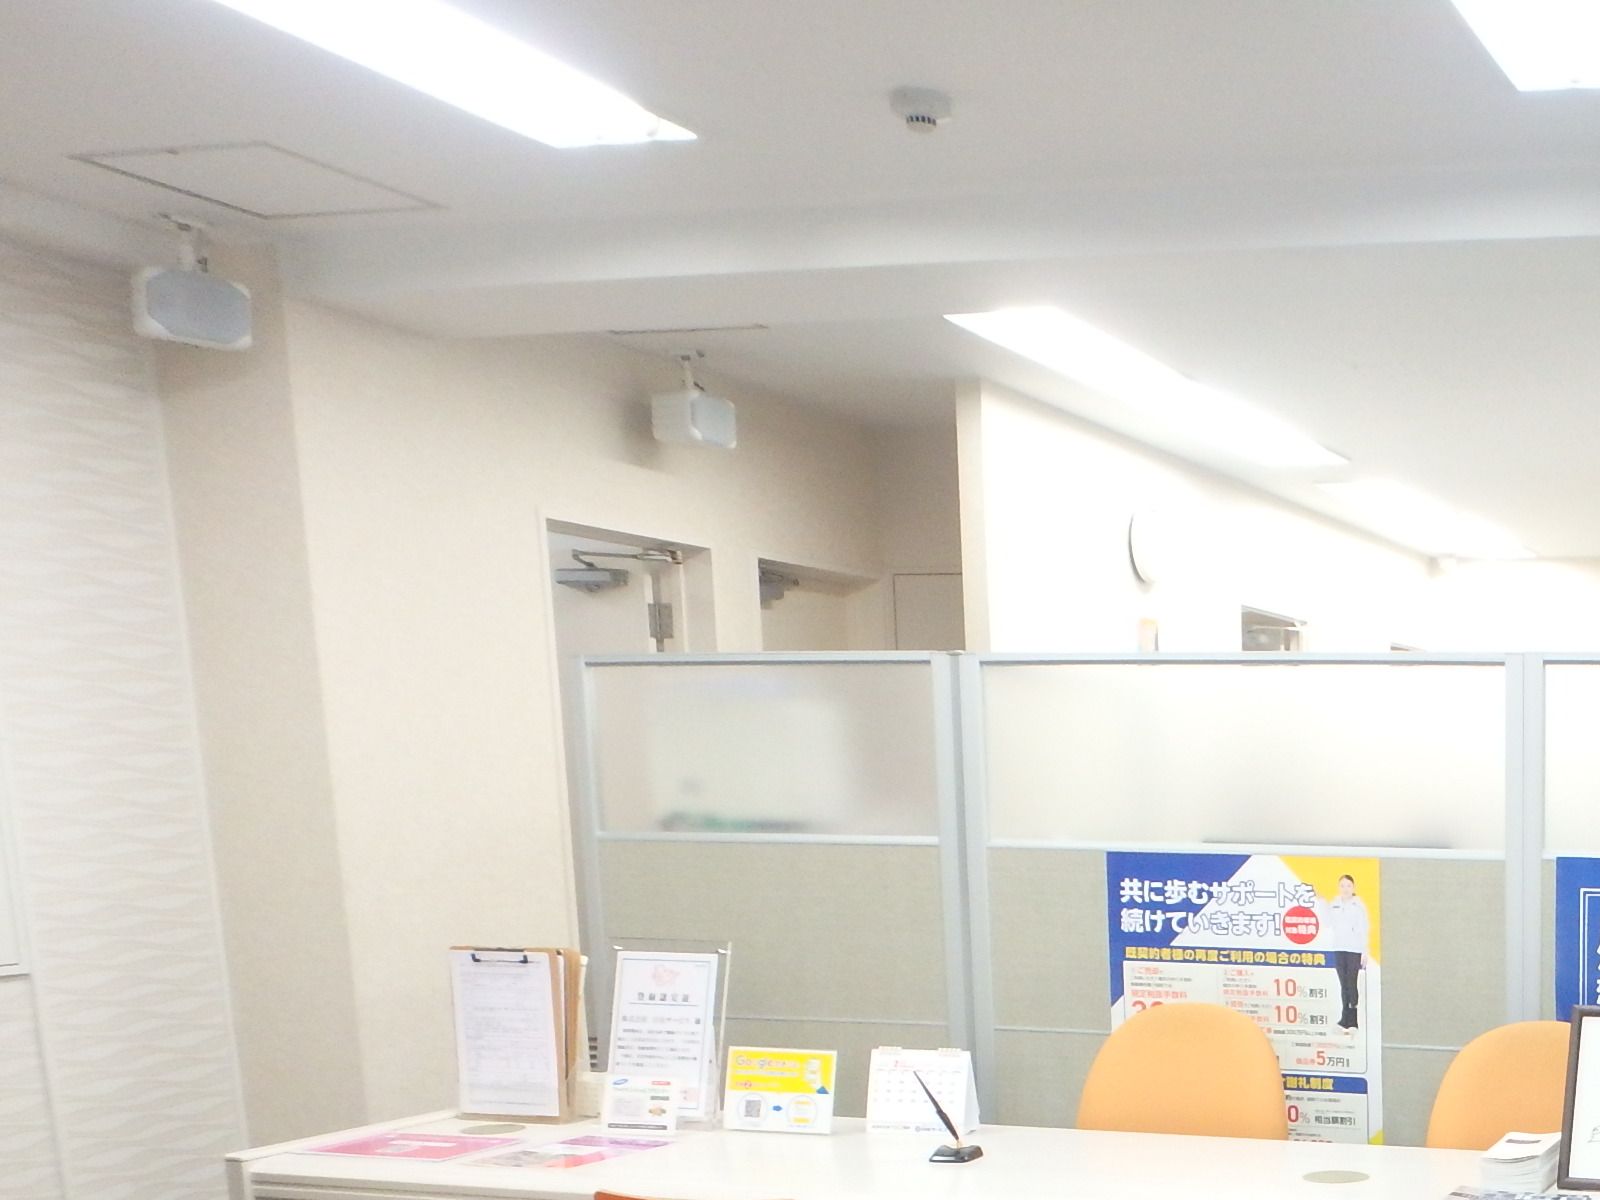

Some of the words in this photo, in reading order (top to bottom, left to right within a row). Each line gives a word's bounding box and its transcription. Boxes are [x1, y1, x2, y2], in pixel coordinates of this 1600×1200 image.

[1119, 877, 1317, 908] 共に歩むサポートを
